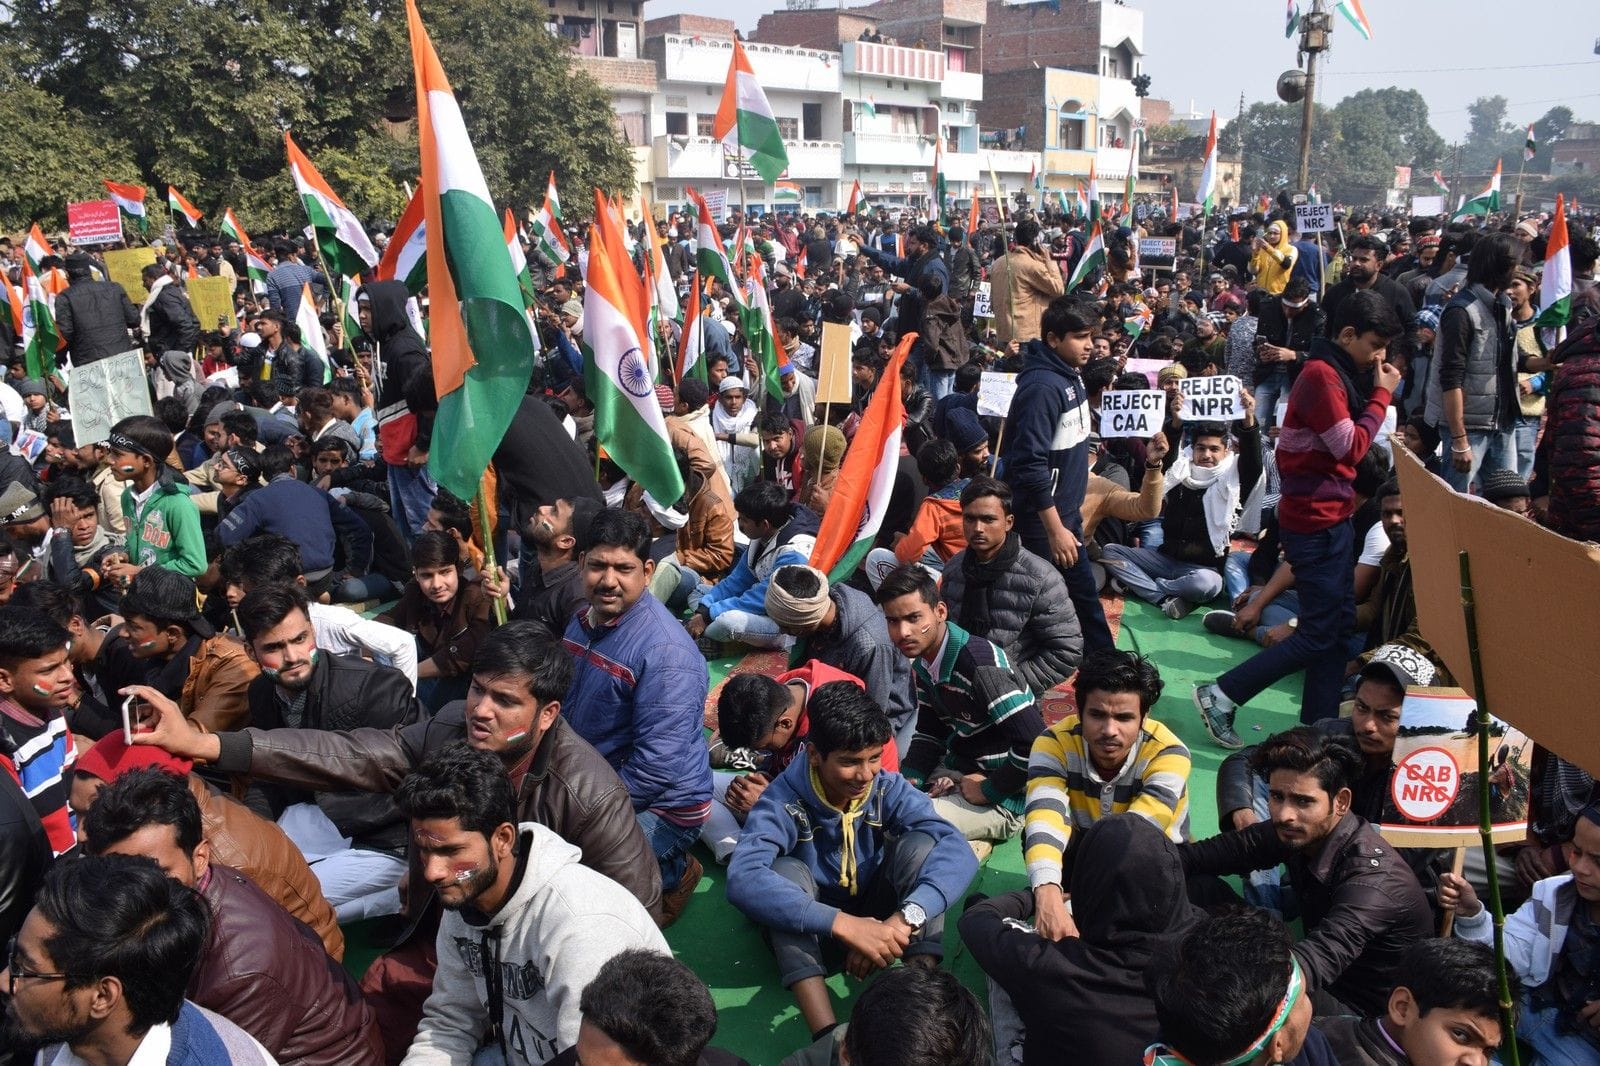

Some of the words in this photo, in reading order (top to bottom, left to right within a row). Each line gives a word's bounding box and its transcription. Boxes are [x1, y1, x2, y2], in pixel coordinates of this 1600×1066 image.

[1297, 206, 1330, 217] REJECT
[1304, 218, 1325, 229] NRC
[1102, 394, 1162, 411] REJECT
[1192, 397, 1234, 416] NPR
[1112, 413, 1149, 432] CAA
[1406, 764, 1451, 784] CAB
[1402, 784, 1449, 803] NRC
